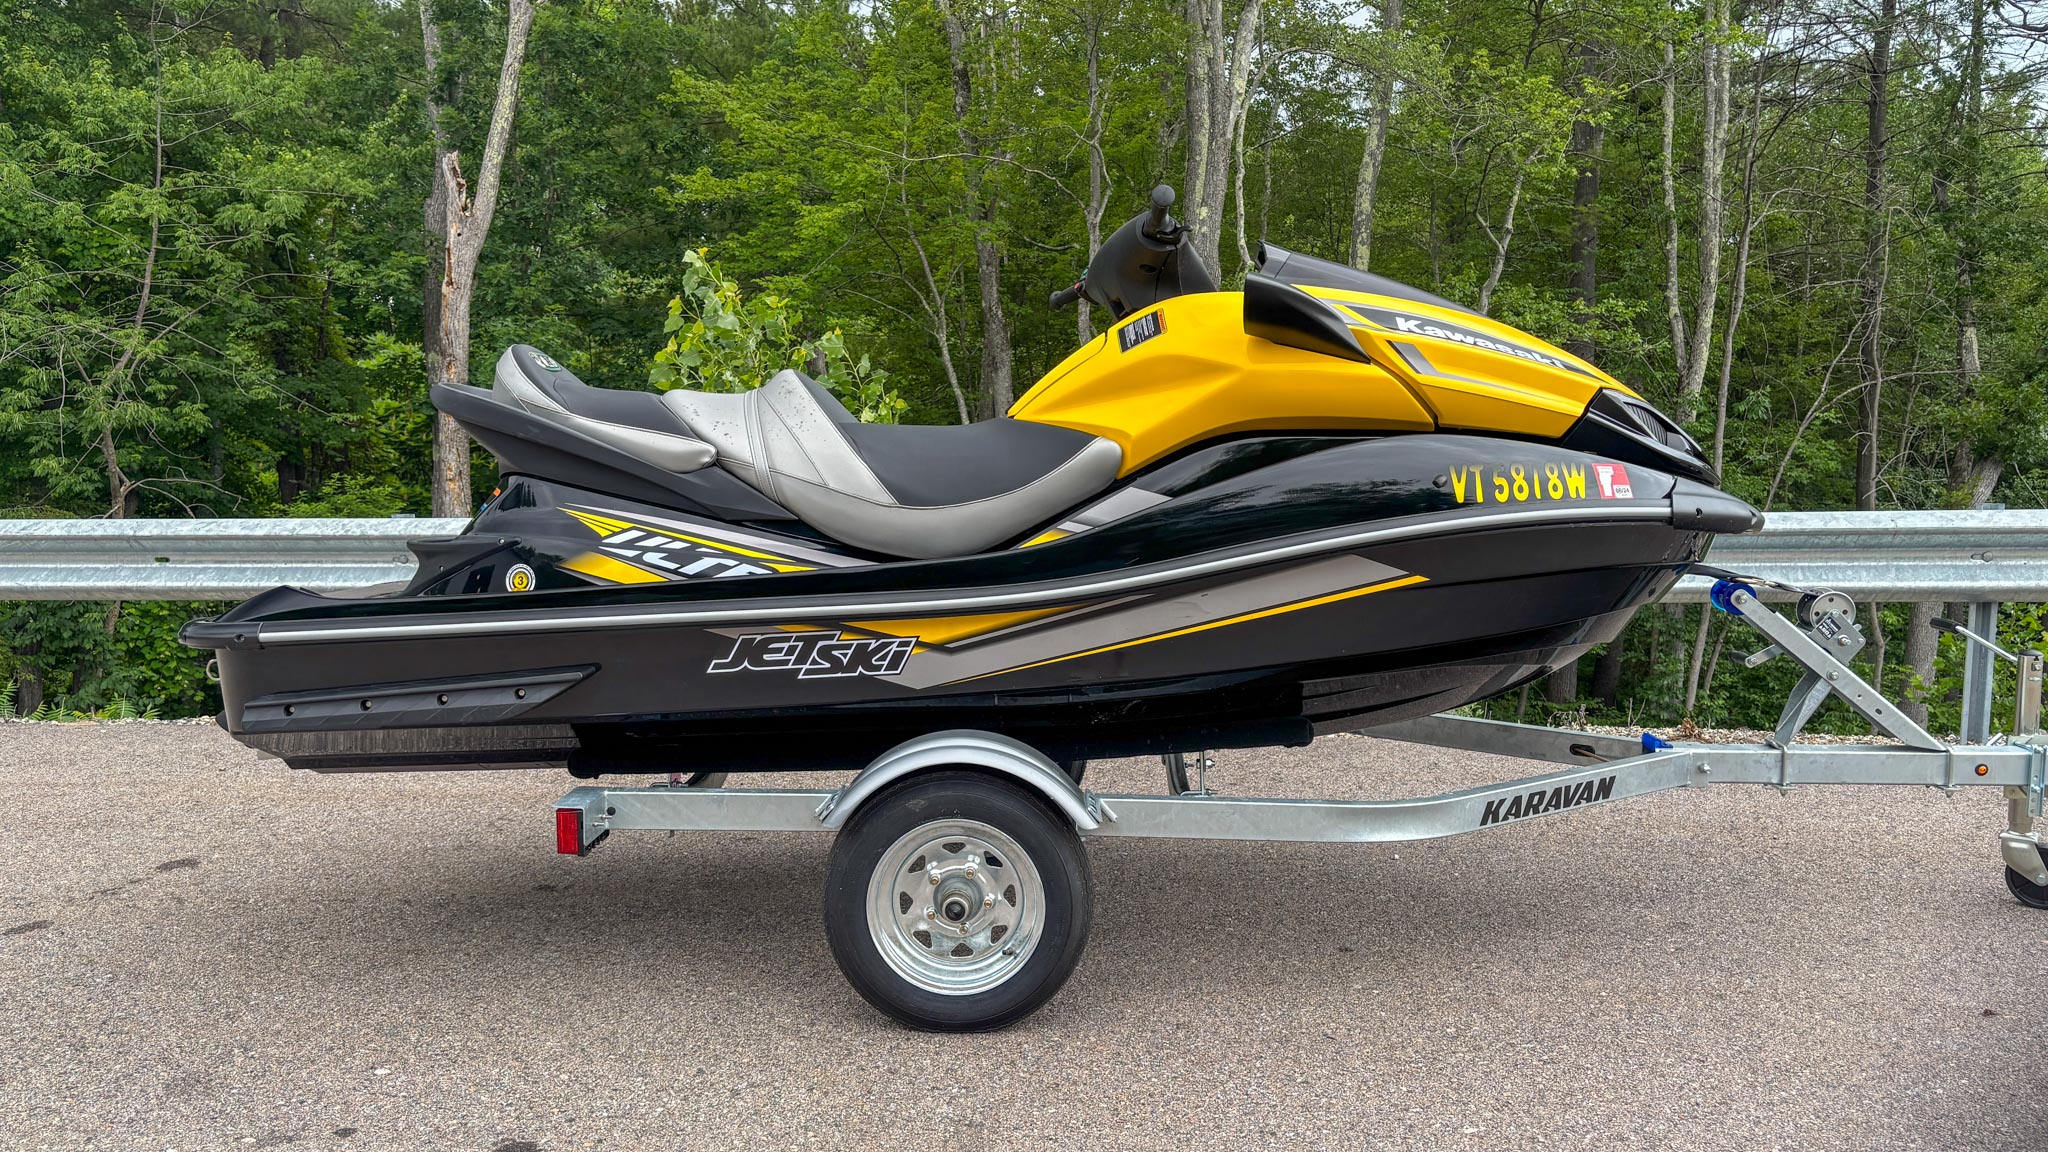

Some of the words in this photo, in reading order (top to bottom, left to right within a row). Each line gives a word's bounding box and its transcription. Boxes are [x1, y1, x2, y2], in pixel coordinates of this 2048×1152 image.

[1395, 316, 1568, 371] Kawasaki
[1449, 464, 1484, 503] VT
[1492, 462, 1586, 503] 5818W
[517, 575, 524, 586] 3
[1479, 775, 1616, 827] KARAVAN
